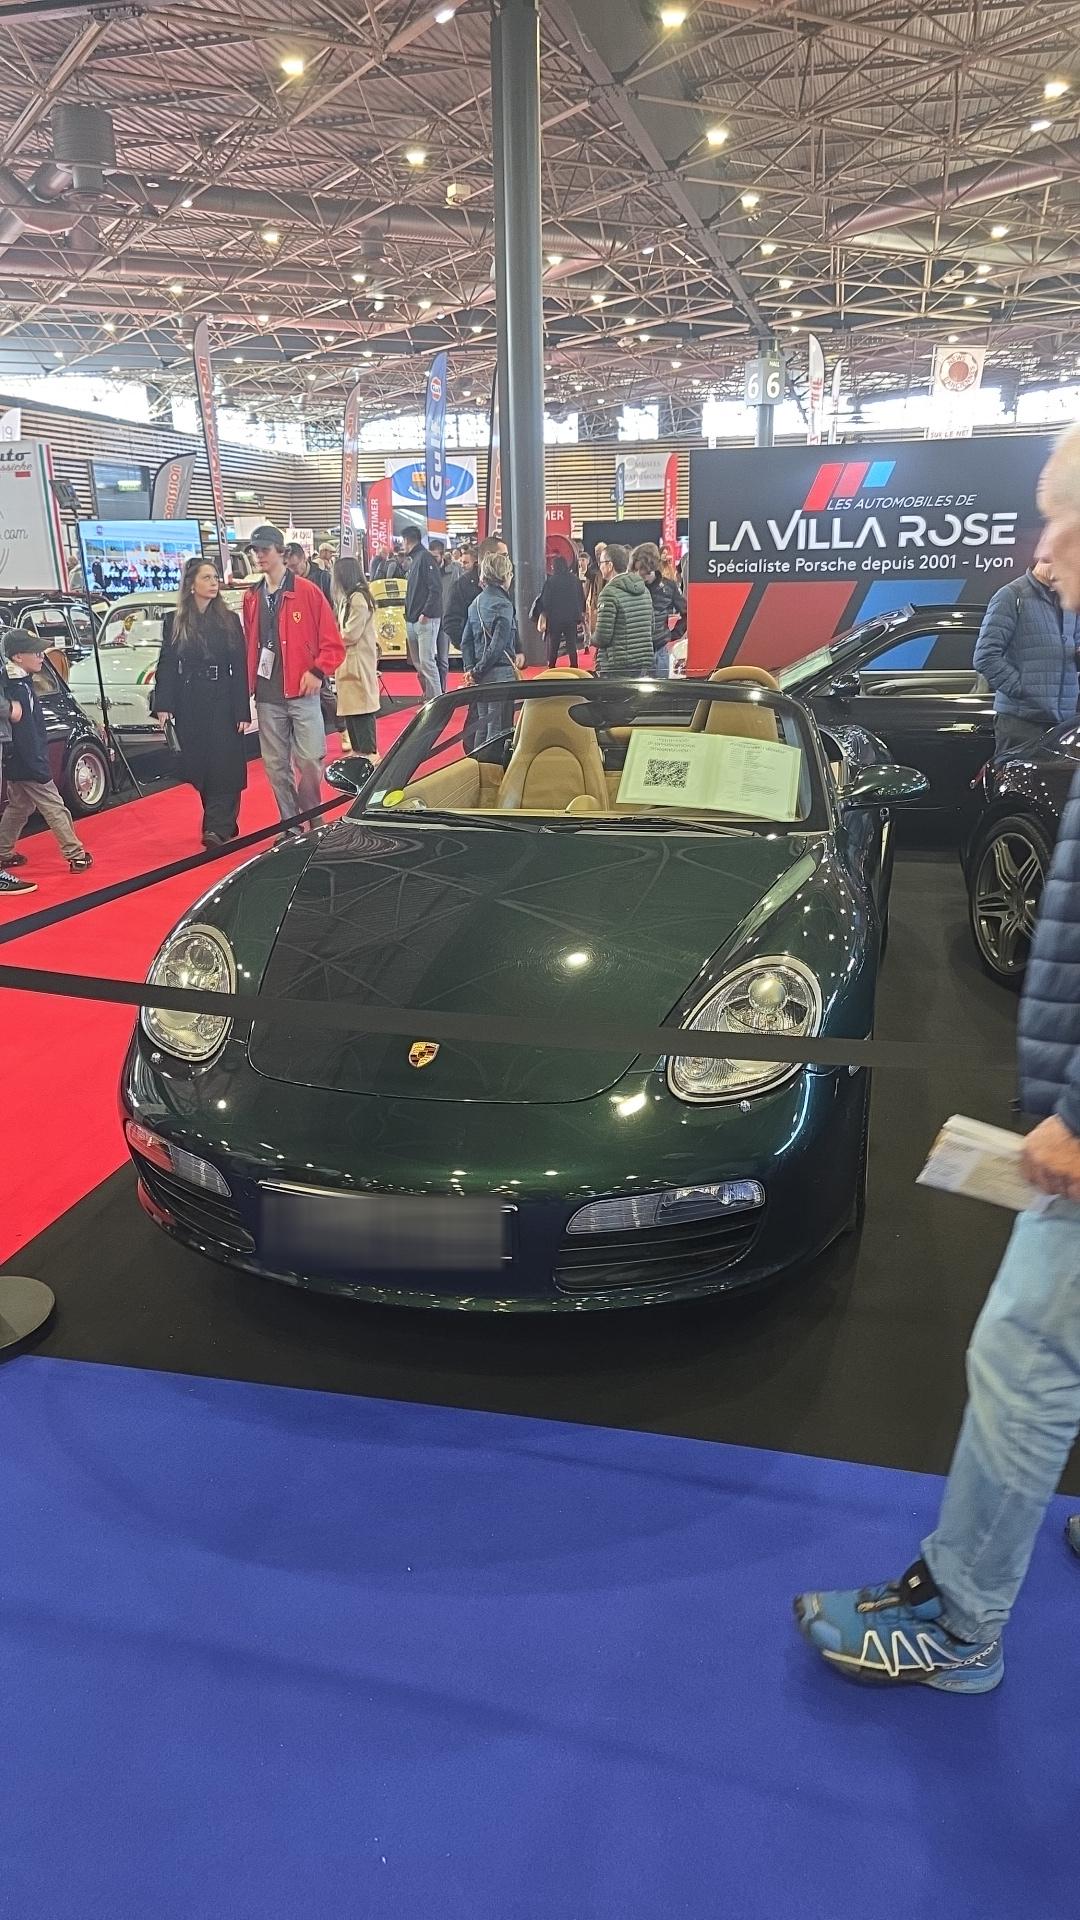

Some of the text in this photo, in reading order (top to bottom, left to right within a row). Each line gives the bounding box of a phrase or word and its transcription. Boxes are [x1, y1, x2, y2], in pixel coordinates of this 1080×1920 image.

[747, 372, 760, 399] 6
[766, 371, 781, 399] 6
[430, 419, 443, 501] Gulf
[826, 493, 978, 511] LES AUTOMOBILES DE
[342, 527, 352, 547] By
[370, 497, 379, 550] OLDTIMER
[708, 509, 1018, 552] LA VILLA ROSE
[707, 556, 791, 576] Spécialiste
[795, 554, 857, 573] Porsche
[861, 553, 916, 574] depuis
[919, 554, 957, 570] 2001
[975, 553, 1014, 571] Lyon
